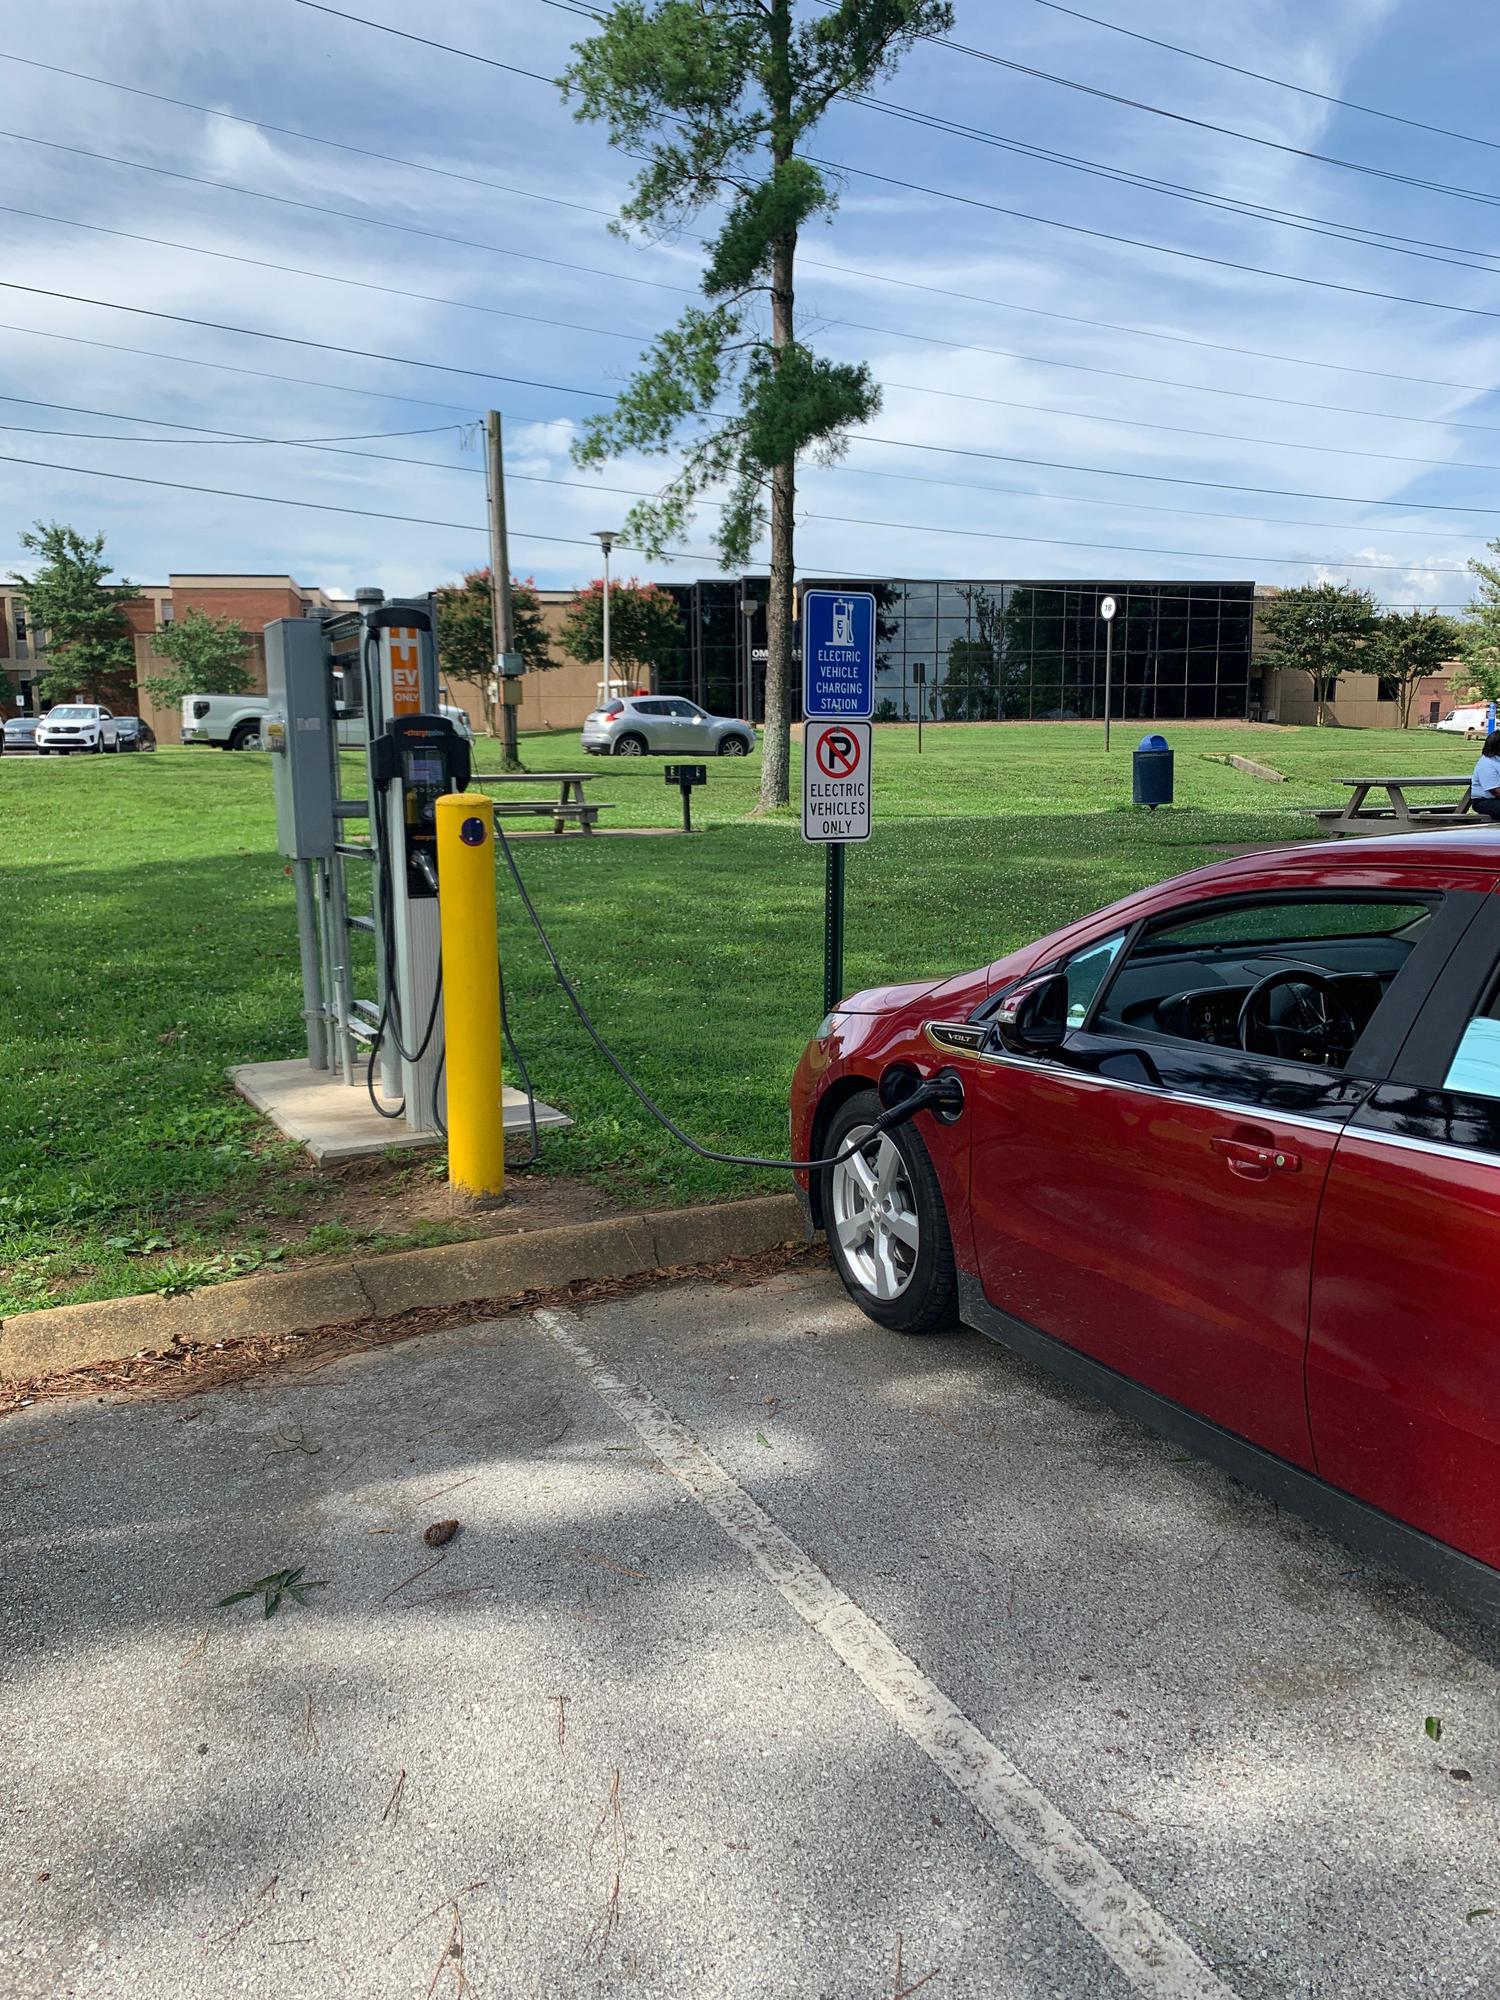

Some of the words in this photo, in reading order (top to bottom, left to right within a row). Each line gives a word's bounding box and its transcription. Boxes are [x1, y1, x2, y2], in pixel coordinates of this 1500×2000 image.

[818, 650, 861, 663] ELECTRIC
[393, 669, 418, 686] EV
[820, 666, 859, 678] VEHICLE
[816, 682, 862, 694] CHARGING
[394, 692, 419, 702] ONLY
[821, 698, 858, 710] STATION
[810, 783, 865, 797] ELECTRIC
[810, 802, 866, 816] VEHICLES
[822, 820, 852, 834] ONLY
[947, 1033, 972, 1042] VOLT
